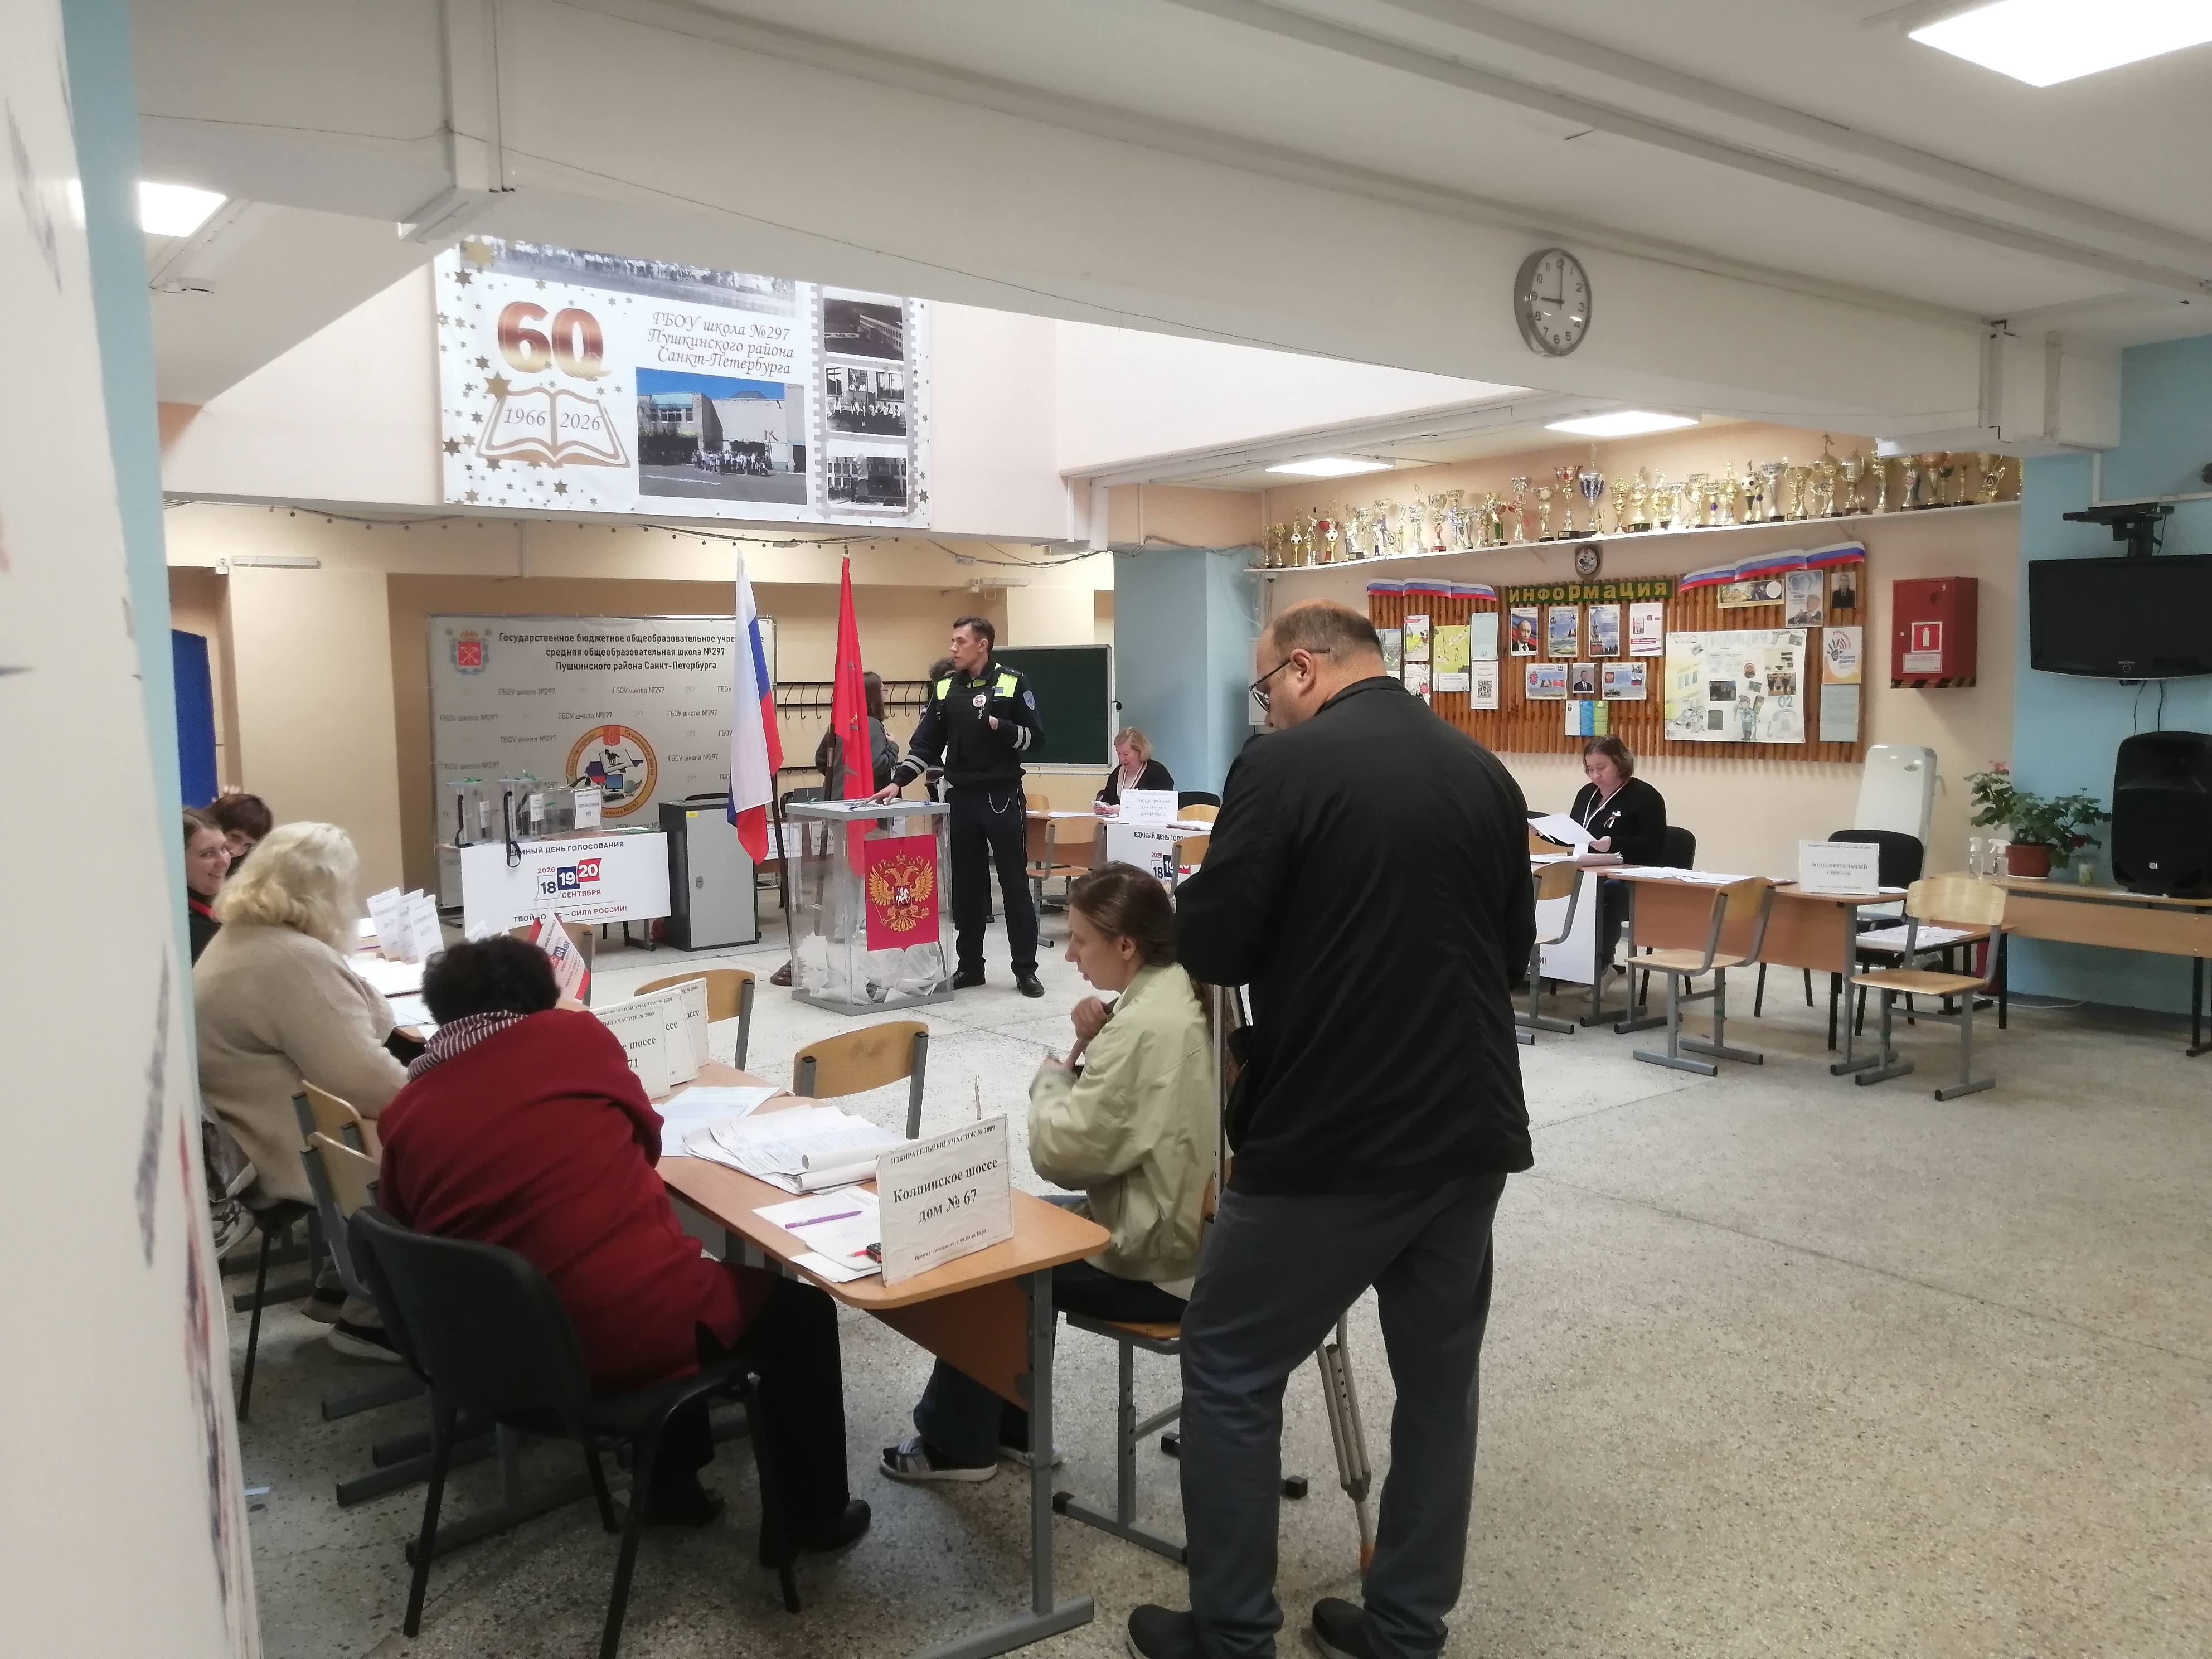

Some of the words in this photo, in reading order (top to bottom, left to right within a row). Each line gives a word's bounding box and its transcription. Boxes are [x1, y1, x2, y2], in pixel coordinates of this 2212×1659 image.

[1570, 268, 1573, 276] 1
[1576, 283, 1582, 293] 2
[1578, 303, 1585, 313] 3
[1535, 312, 1542, 321] 8
[653, 312, 701, 331] ГБОУ
[704, 321, 745, 337] школа
[749, 324, 790, 341] №297
[1543, 327, 1549, 337] 7
[498, 301, 605, 381] 60
[1554, 334, 1560, 345] 6
[1565, 332, 1571, 341] 5
[648, 328, 744, 354] Пушкинского
[748, 343, 794, 358] района
[658, 346, 790, 377] Санкт-Петербурга
[504, 408, 547, 426] 1966
[560, 413, 603, 430] 2026
[499, 633, 575, 643] Государственное
[576, 633, 624, 644] бюджетное
[627, 634, 715, 644] общеобразовательное
[546, 649, 582, 658] средняя
[584, 647, 676, 658] общеобразовательная
[704, 647, 725, 656] №297
[556, 661, 611, 672] Пушкинского
[613, 660, 642, 671] района
[644, 661, 717, 671] Санкт-Петербурга
[1778, 696, 1794, 708] 02
[1134, 831, 1155, 840] ЕДИНЫЙ
[567, 841, 624, 851] ГОЛОСОВАНИЯ
[1153, 866, 1163, 879] 18
[540, 881, 556, 895] 18
[559, 872, 576, 886] 19
[578, 864, 598, 878] 20
[562, 889, 601, 898] СЕНТЯБРЯ
[594, 906, 627, 915] РОССИИ!
[513, 913, 535, 923] ТВОЙ
[614, 1015, 638, 1024] УЧАСТОК
[665, 1021, 678, 1031] ссе
[629, 1037, 656, 1050] шоссе
[891, 1139, 947, 1165] ИЗБИРАТЕЛЬНЫЙ
[948, 1131, 976, 1146] УЧАСТОК
[984, 1124, 995, 1134] 2009
[893, 1170, 963, 1203] Колпинское
[966, 1158, 998, 1179] шоссе
[919, 1205, 943, 1224] дом
[946, 1195, 961, 1212] №
[963, 1188, 977, 1205] 67
